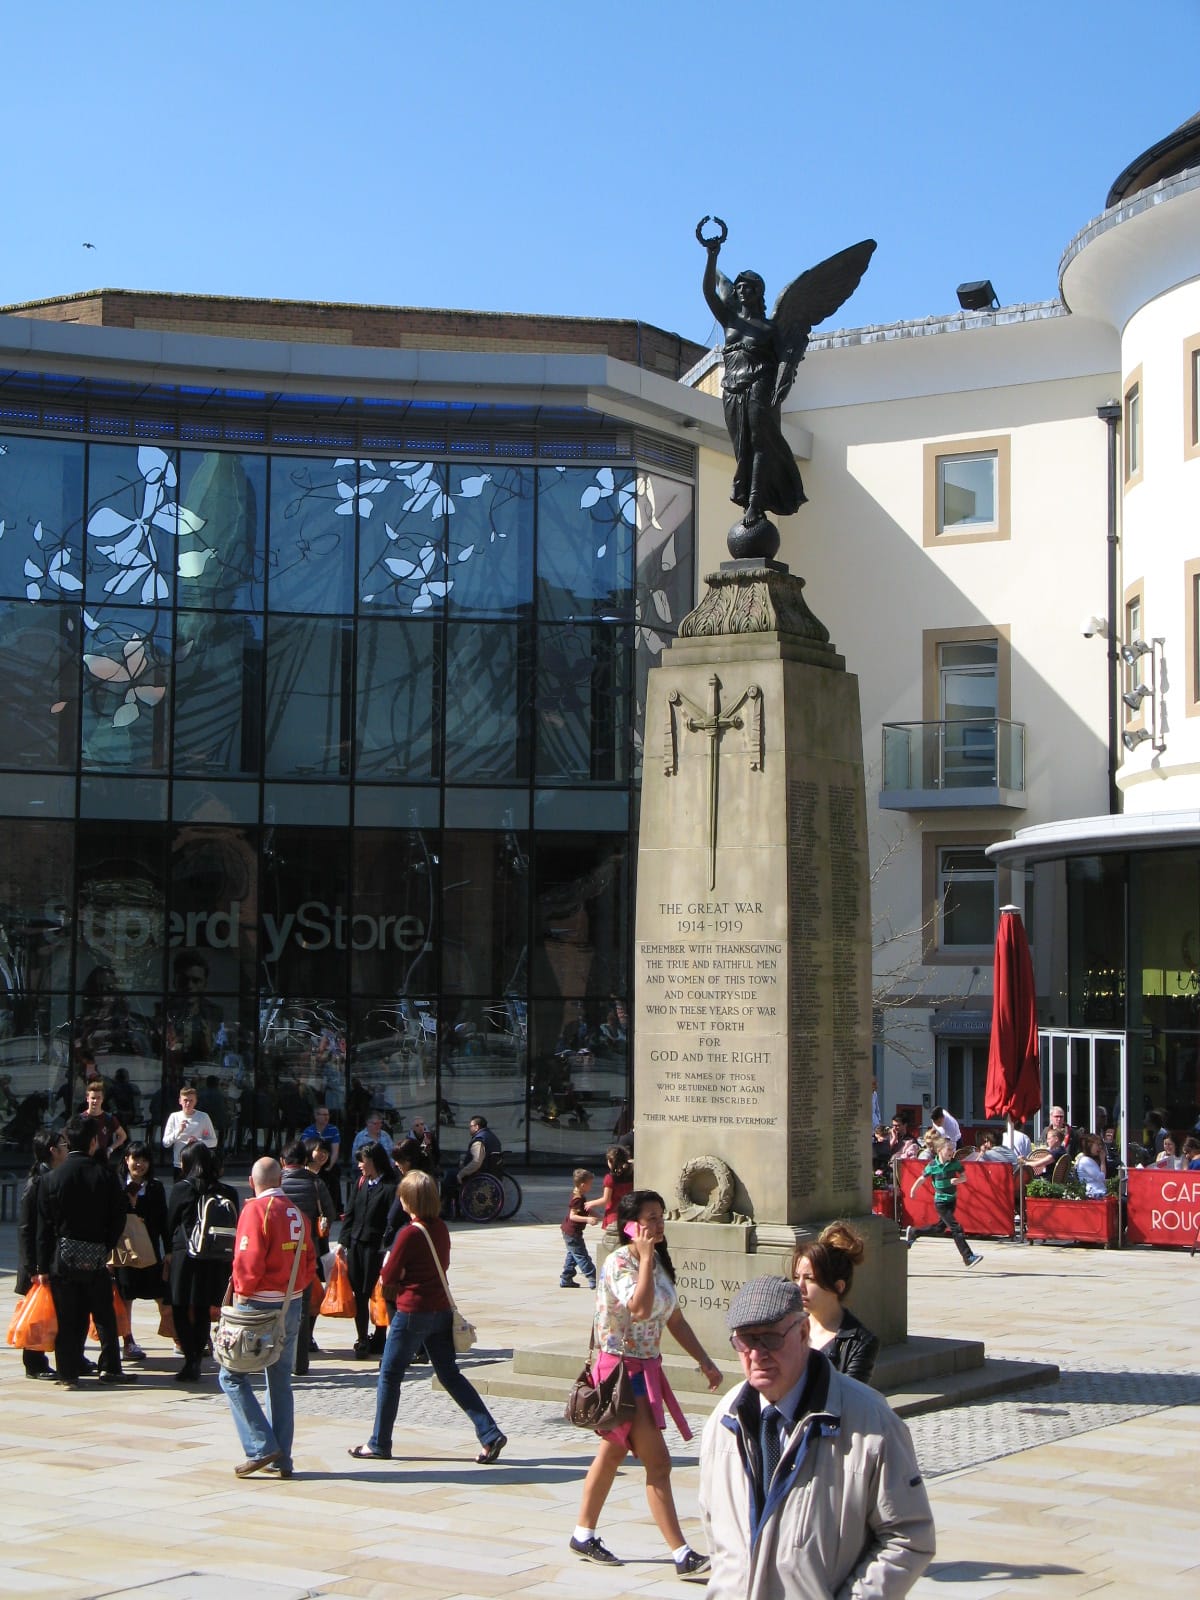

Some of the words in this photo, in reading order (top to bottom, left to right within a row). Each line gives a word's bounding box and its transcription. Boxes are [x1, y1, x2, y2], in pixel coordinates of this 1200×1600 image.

[659, 903, 682, 915] THE
[688, 903, 729, 914] GREAT
[735, 902, 763, 913] WAR
[678, 920, 743, 933] 1914-1919
[640, 945, 685, 954] REMEMBER
[688, 945, 712, 954] WITH
[716, 945, 782, 954] THANKSGIVING
[646, 960, 663, 969] THE
[667, 960, 689, 969] TRUE
[692, 960, 709, 969] AND
[713, 960, 753, 969] FAITHFUL
[757, 960, 777, 969] MEN
[646, 975, 664, 984] AND
[668, 975, 705, 984] WOMEN
[708, 975, 720, 984] OF
[724, 975, 745, 984] THIS
[748, 975, 777, 984] TOWN
[664, 991, 684, 1000] AND
[687, 991, 757, 1000] COUNTRYSIDE
[646, 1005, 667, 1015] WHO
[669, 1005, 677, 1015] IN
[680, 1005, 707, 1015] THESE
[709, 1006, 739, 1016] YEARS
[742, 1006, 754, 1016] OF
[756, 1007, 776, 1016] WAR
[677, 1021, 706, 1031] WENT
[711, 1021, 744, 1031] FORTH
[699, 1037, 721, 1047] FOR
[650, 1050, 679, 1062] GOD
[683, 1053, 703, 1062] AND
[707, 1053, 728, 1063] THE
[665, 1071, 681, 1079] THE
[684, 1072, 712, 1080] NAMES
[729, 1073, 756, 1081] THOSE
[657, 1083, 675, 1091] WHO
[678, 1084, 718, 1092] RETURNED
[720, 1085, 737, 1093] NOT
[739, 1086, 765, 1094] AGAIN
[664, 1095, 681, 1103] ARE
[669, 1114, 689, 1122] NAME
[692, 1115, 717, 1124] LIVETH
[719, 1116, 734, 1124] FOR
[287, 1207, 302, 1240] 2
[682, 1261, 706, 1271] AND
[721, 1279, 747, 1292] WA
[679, 1295, 730, 1312] 9-1945
